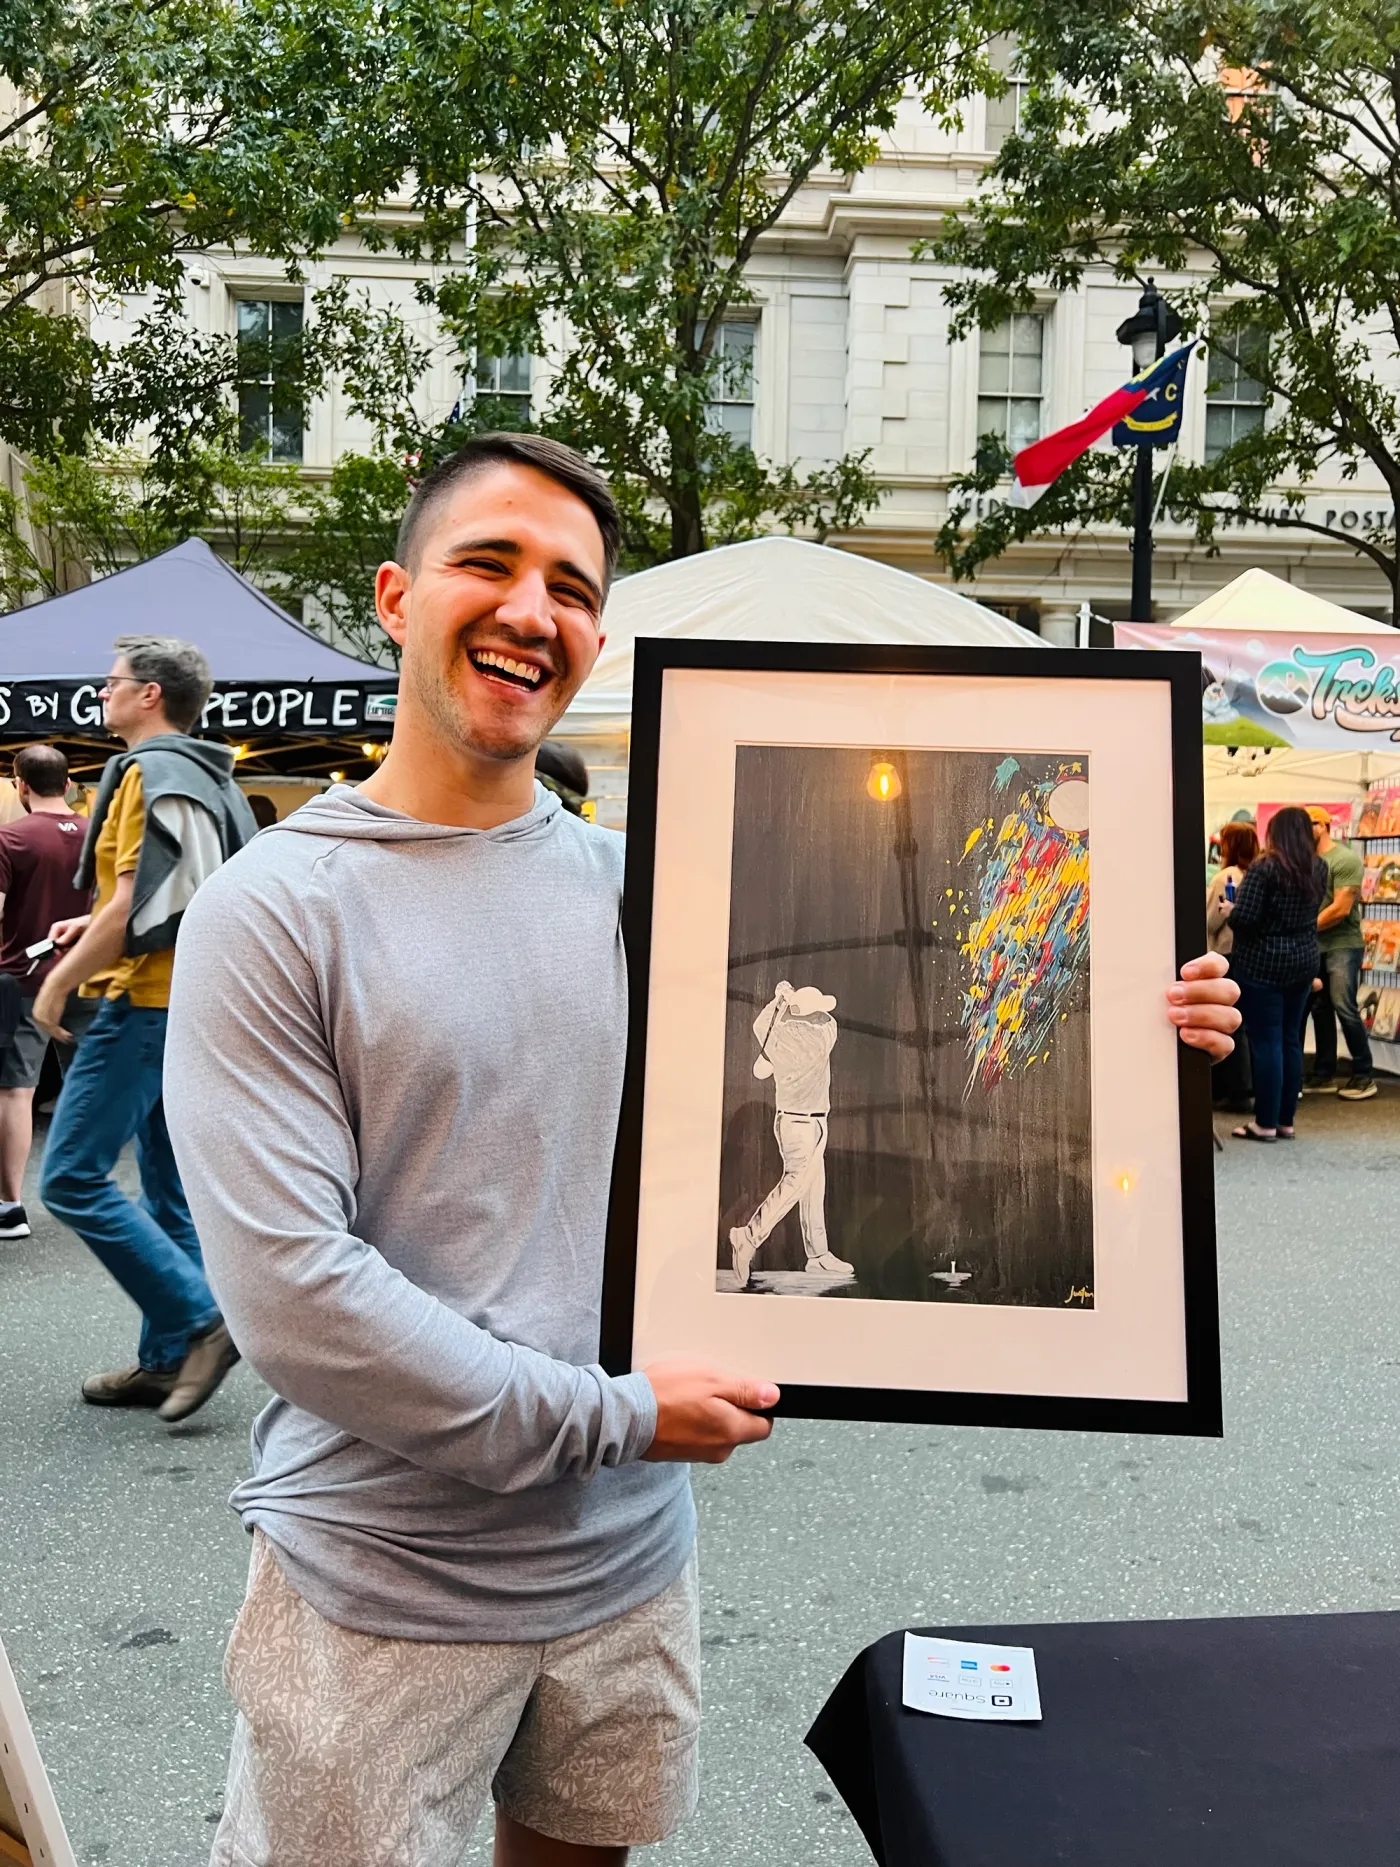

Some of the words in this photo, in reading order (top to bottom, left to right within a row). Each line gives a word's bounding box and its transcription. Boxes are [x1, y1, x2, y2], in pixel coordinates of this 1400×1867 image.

[25, 691, 59, 721] BY
[200, 688, 360, 729] PEOPLE
[928, 1689, 986, 1704] Square
